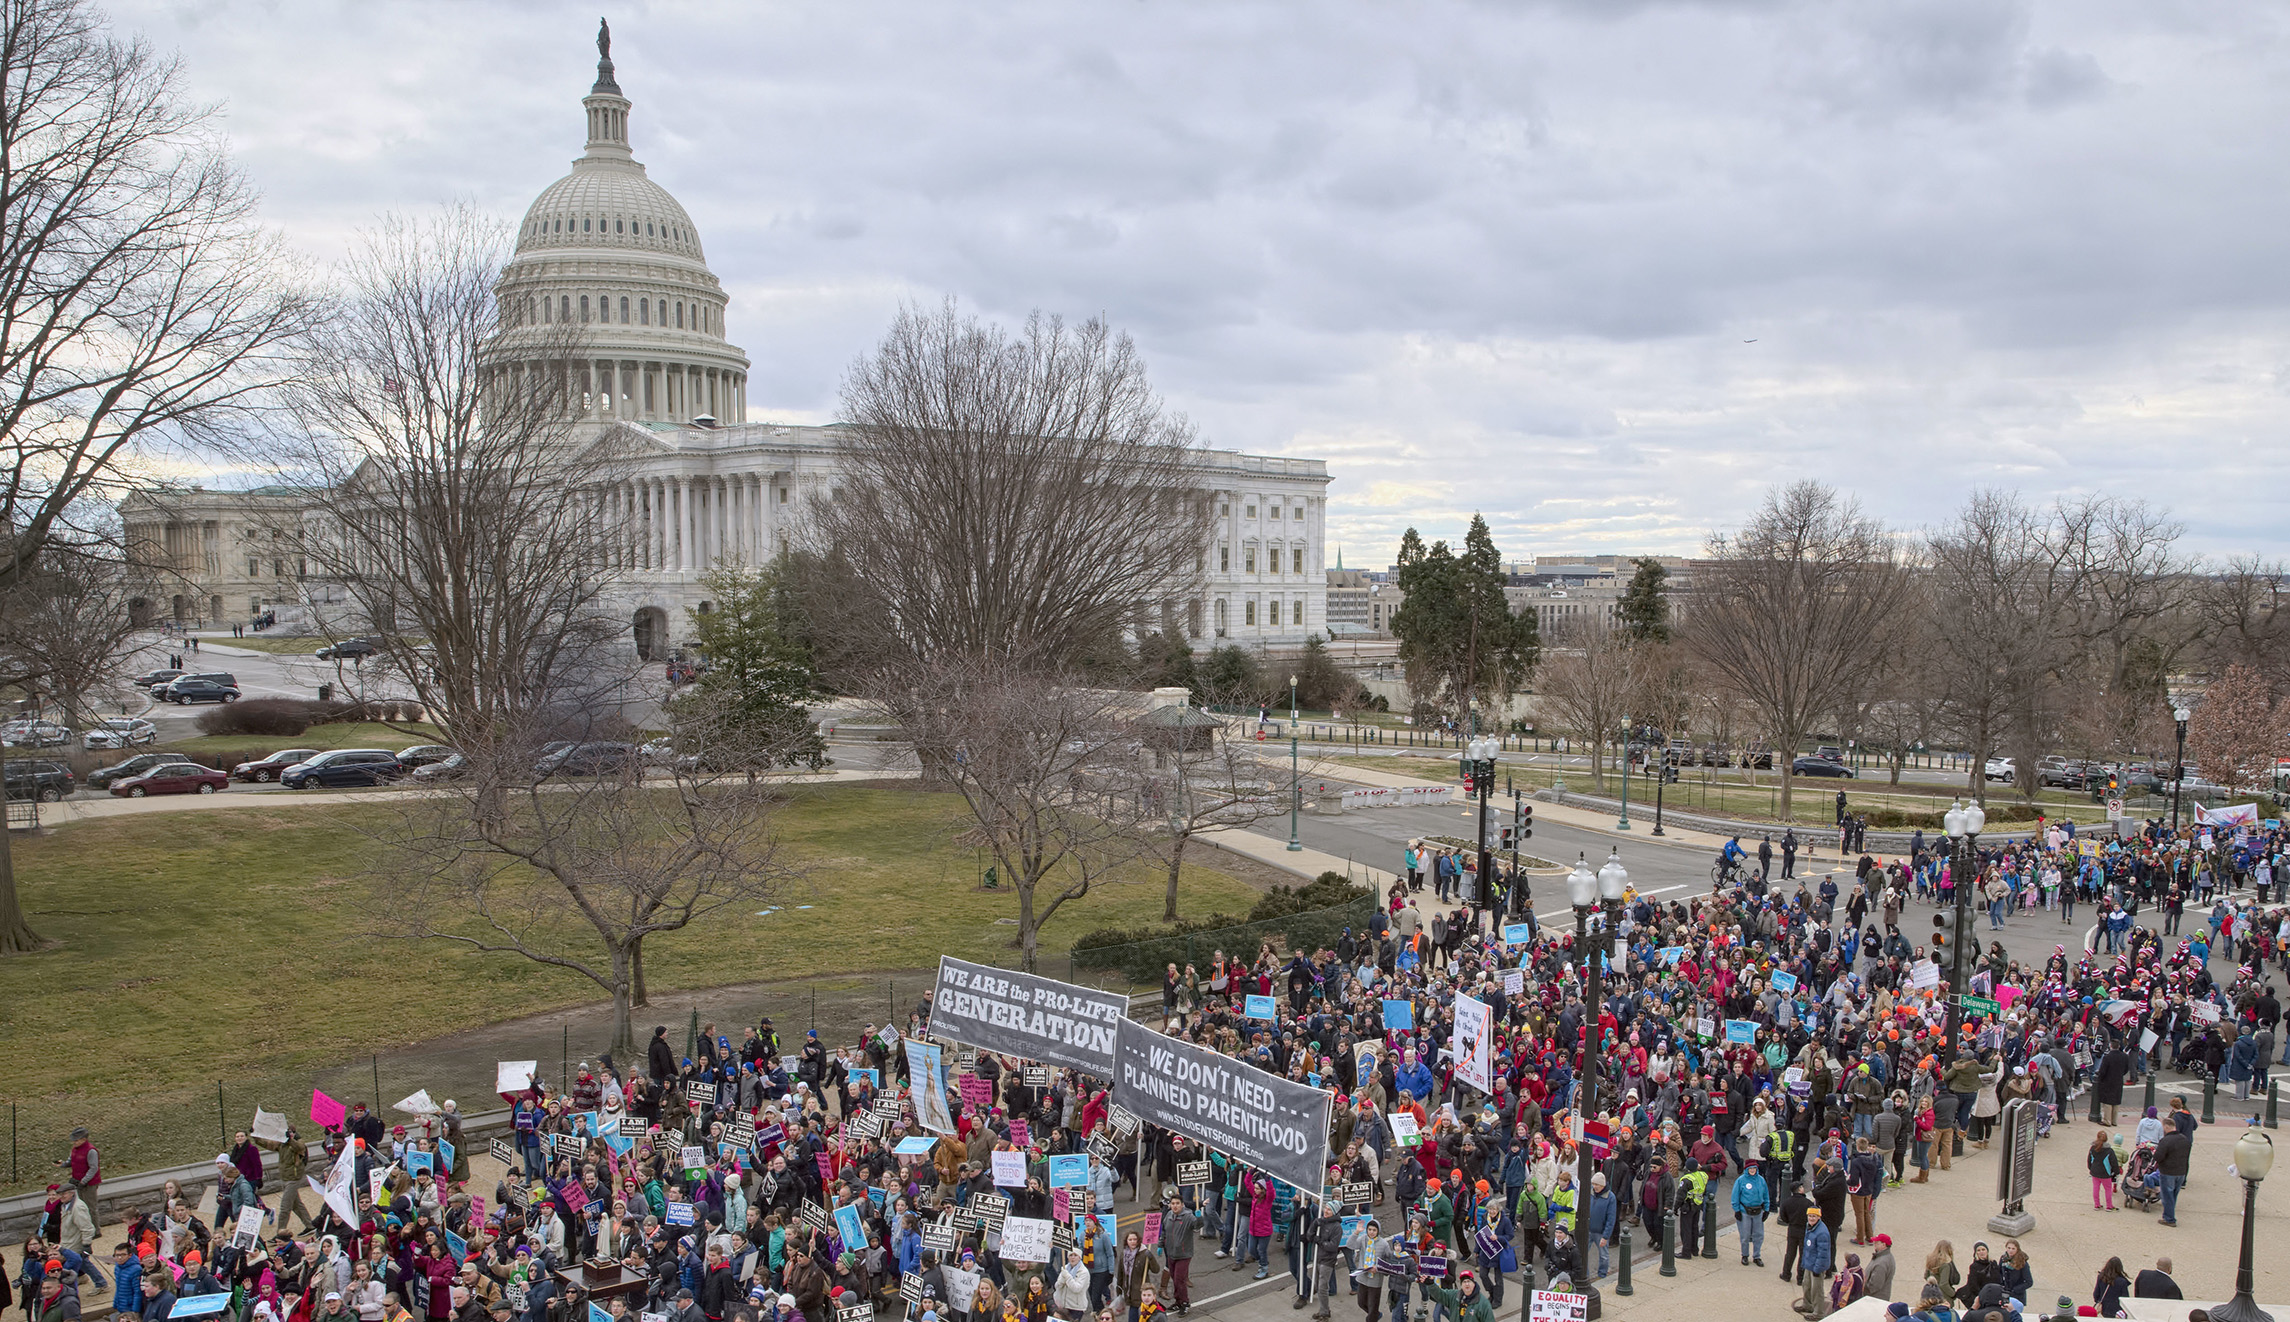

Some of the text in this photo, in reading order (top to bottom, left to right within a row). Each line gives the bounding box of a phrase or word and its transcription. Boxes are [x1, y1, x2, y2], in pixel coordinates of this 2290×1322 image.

[944, 965, 1120, 1024] WE ARE the PRO-LIFE
[1963, 997, 1990, 1009] Delaware
[1973, 1008, 1985, 1016] UNIT
[938, 988, 1114, 1055] GENERATION
[1150, 1045, 1275, 1113] WE DON'T NEED
[1124, 1063, 1308, 1155] PLANNED PARENTHOOD
[684, 1150, 703, 1158] CHOOSE
[984, 1196, 1006, 1206] AM
[1056, 1195, 1067, 1203] KILLS
[933, 1227, 952, 1236] AM
[1006, 1220, 1046, 1236] Marching for
[1014, 1235, 1032, 1243] LIVES
[1538, 1292, 1586, 1305] EQUALITY
[851, 1306, 871, 1317] AM
